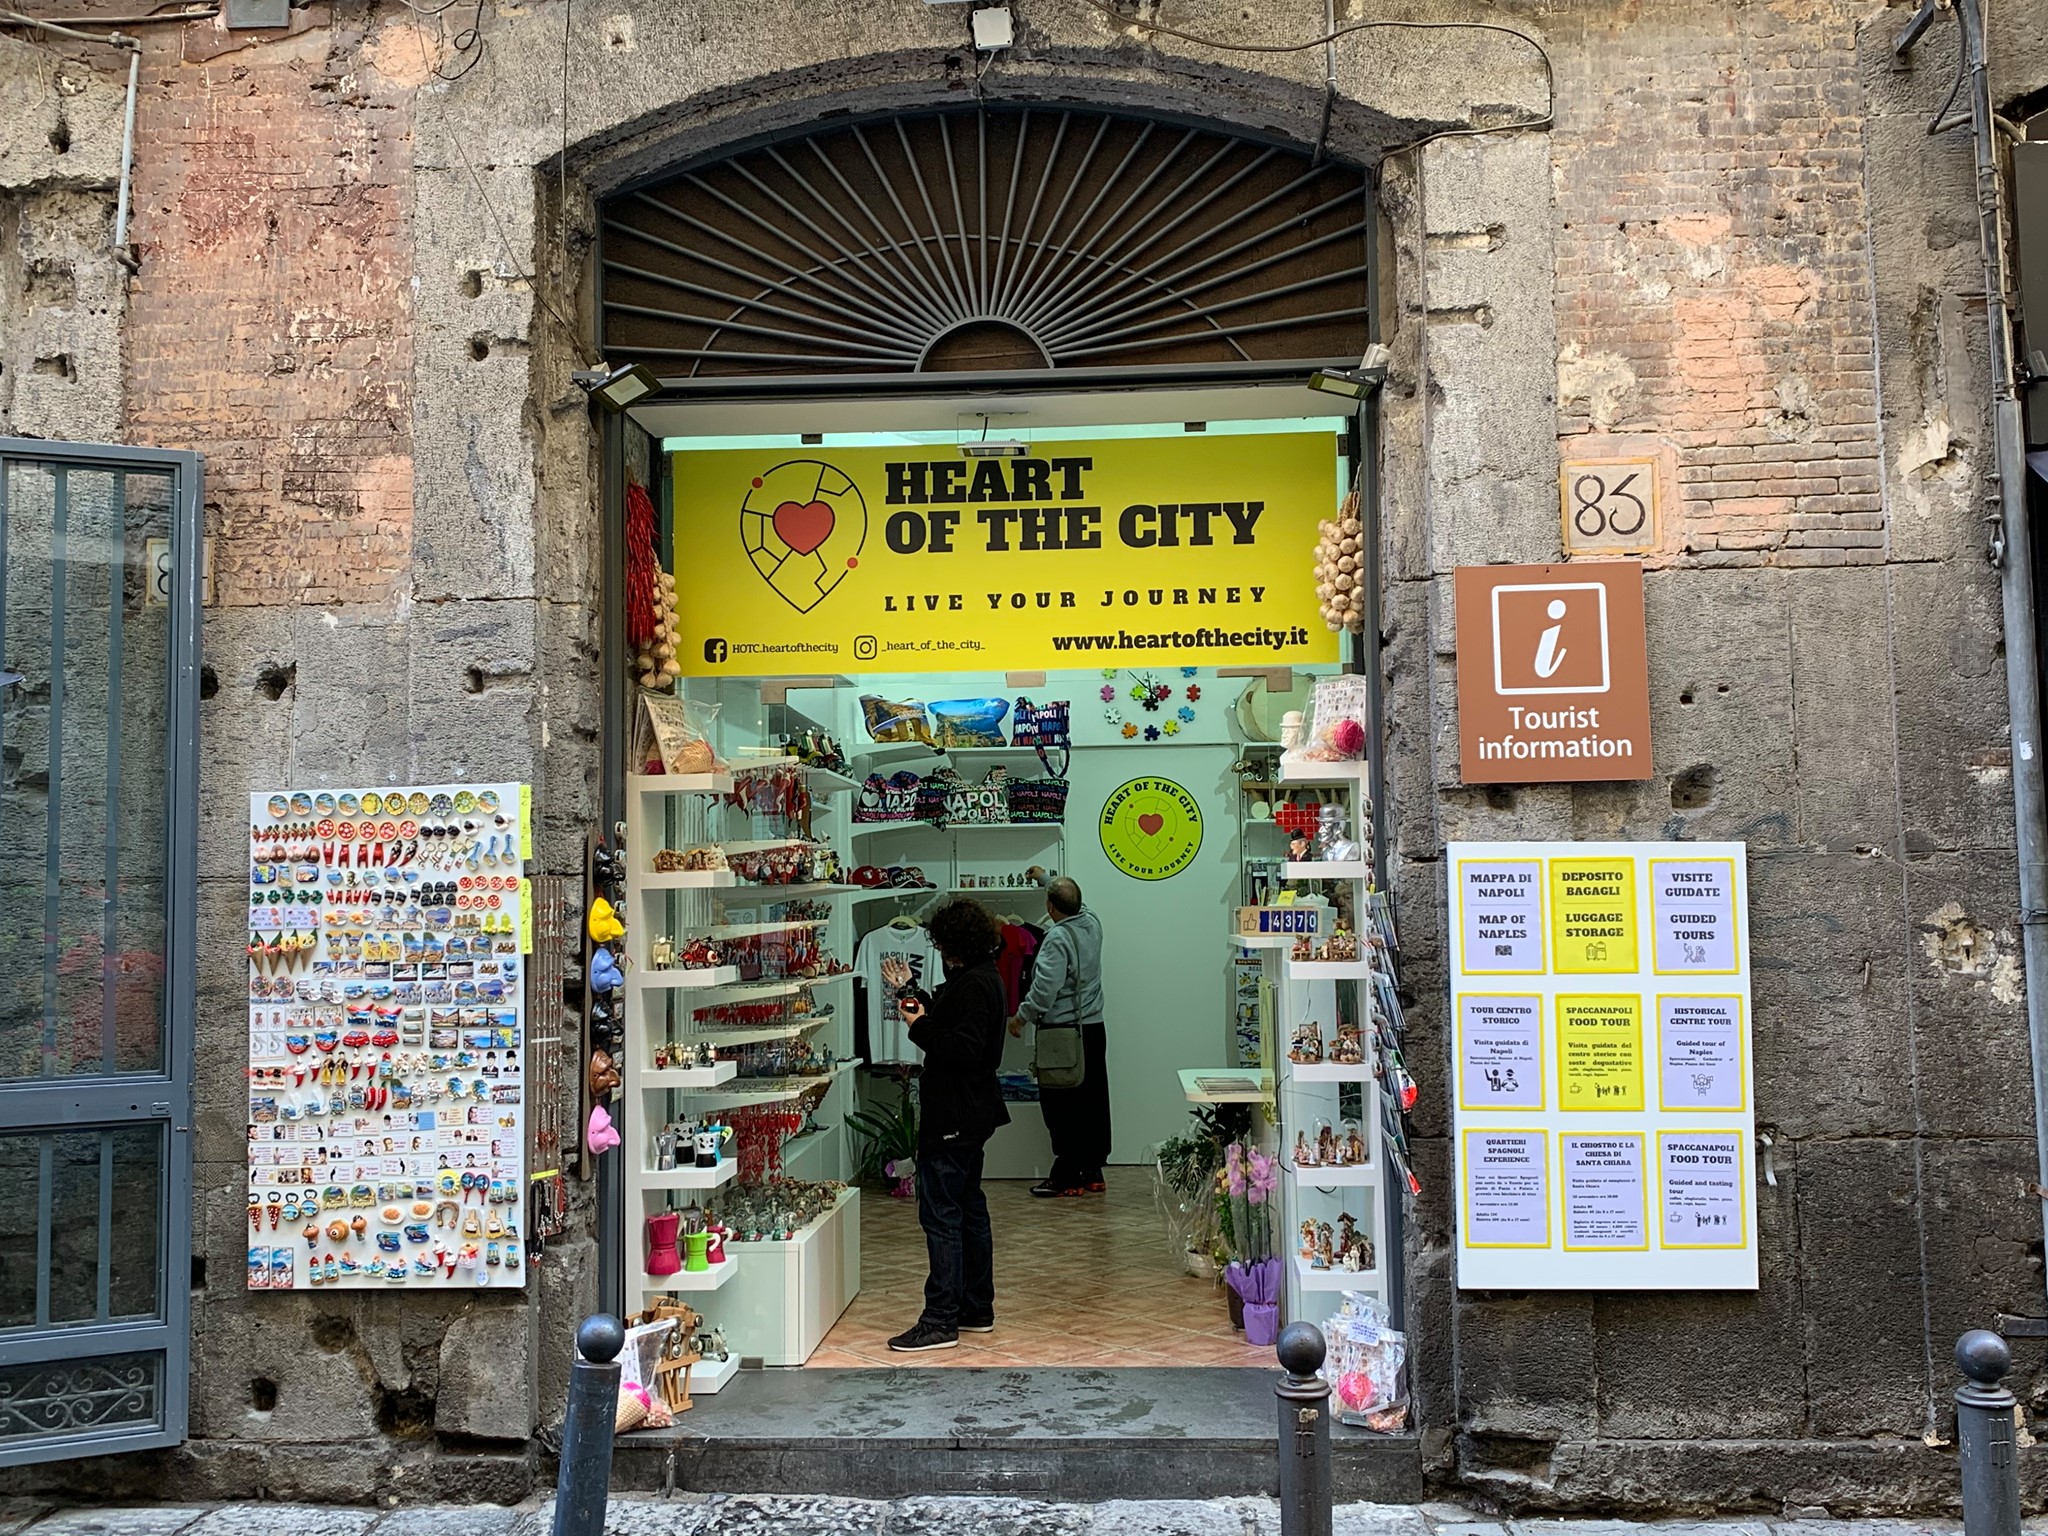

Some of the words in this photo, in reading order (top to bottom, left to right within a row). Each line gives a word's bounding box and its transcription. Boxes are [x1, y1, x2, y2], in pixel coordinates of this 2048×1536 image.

[885, 456, 1093, 505] HEART
[1574, 472, 1646, 537] 86
[885, 510, 960, 554] OF
[977, 506, 1102, 552] THE
[1118, 501, 1265, 548] CITY
[884, 594, 963, 612] LIVE
[987, 592, 1076, 609] YOUR
[1100, 586, 1266, 607] JOURNEY
[1052, 625, 1309, 651] www.heartofthecity.it
[1508, 705, 1600, 730] Tourist
[1478, 734, 1633, 760] information
[1104, 787, 1132, 825] HEART
[1134, 781, 1150, 792] OF
[1153, 781, 1179, 798] THE
[1178, 795, 1198, 823] CITY
[1109, 843, 1126, 864] LIVE
[1128, 862, 1153, 874] YOUR
[1158, 841, 1194, 874] JOURNEY
[1470, 873, 1516, 883] MAPPA
[1518, 873, 1532, 883] DI
[1562, 872, 1624, 882] DEPOSITO
[1671, 873, 1713, 882] VISITE
[1478, 888, 1525, 898] NAPOLI
[1566, 886, 1621, 896] BAGAGLI
[1665, 887, 1721, 897] GUIDATE
[1273, 914, 1317, 928] 4370
[1478, 914, 1507, 924] MAP
[1510, 914, 1526, 924] OF
[1565, 913, 1623, 923] LUGGAGE
[1670, 914, 1717, 924] GUIDED
[1478, 929, 1528, 939] NAPLES
[1565, 927, 1624, 937] STORAGE
[1673, 930, 1715, 940] TOURS
[1470, 1006, 1494, 1014] TOUR
[1569, 1018, 1598, 1026] FOOD
[1600, 1018, 1631, 1026] TOUR
[1495, 1039, 1520, 1047] guidata
[1591, 1042, 1617, 1050] guidata
[1667, 1143, 1735, 1152] SPACCANAPOLI
[1670, 1154, 1699, 1164] FOOD
[1702, 1155, 1732, 1164] TOUR
[1708, 1180, 1733, 1188] tasting
